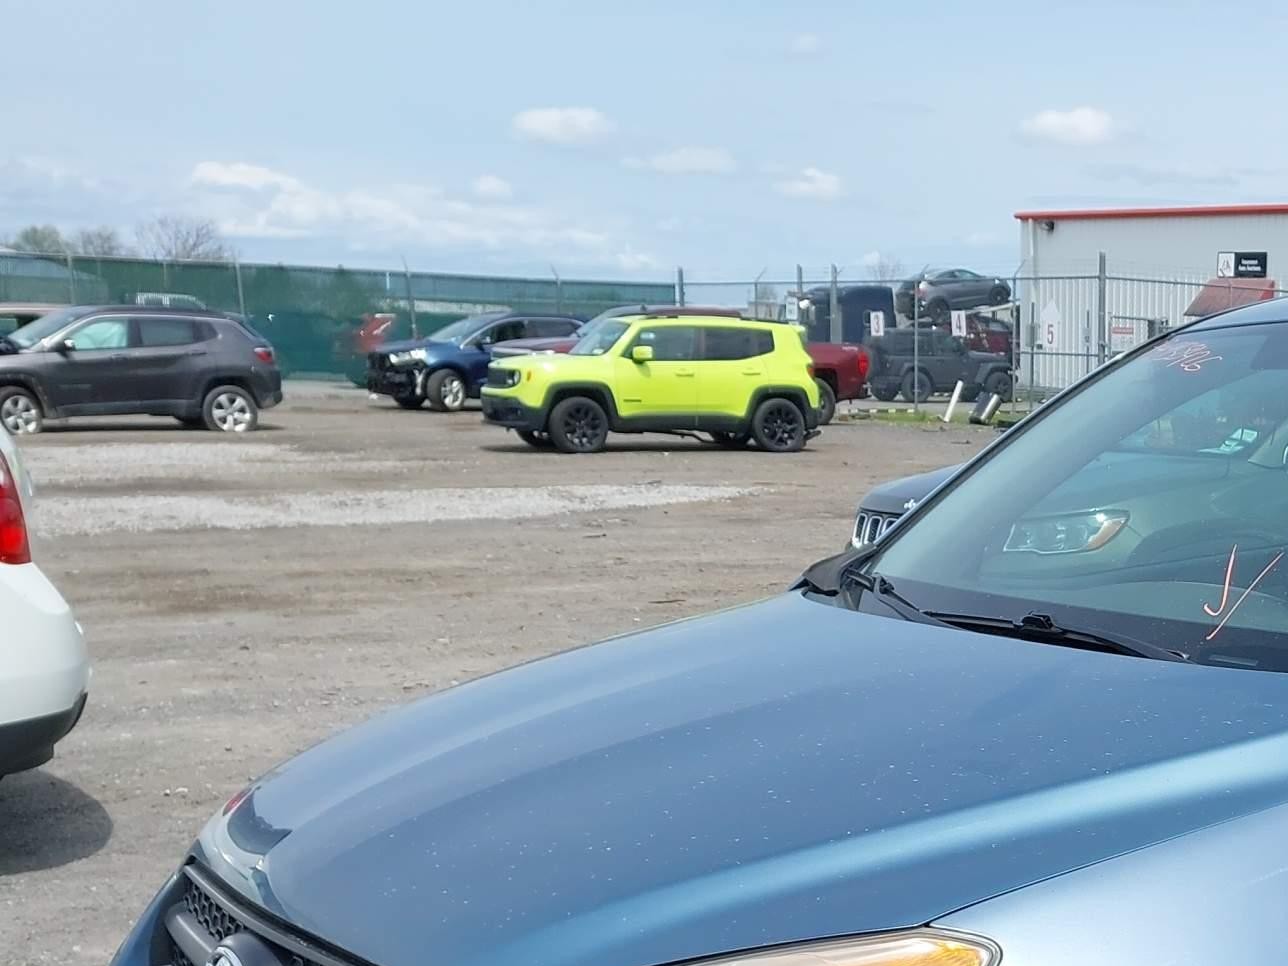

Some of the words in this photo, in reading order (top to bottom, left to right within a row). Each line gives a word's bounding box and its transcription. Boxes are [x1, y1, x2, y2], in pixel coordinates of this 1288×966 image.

[873, 316, 880, 334] 3
[955, 315, 962, 333] 4
[1047, 324, 1054, 345] 5
